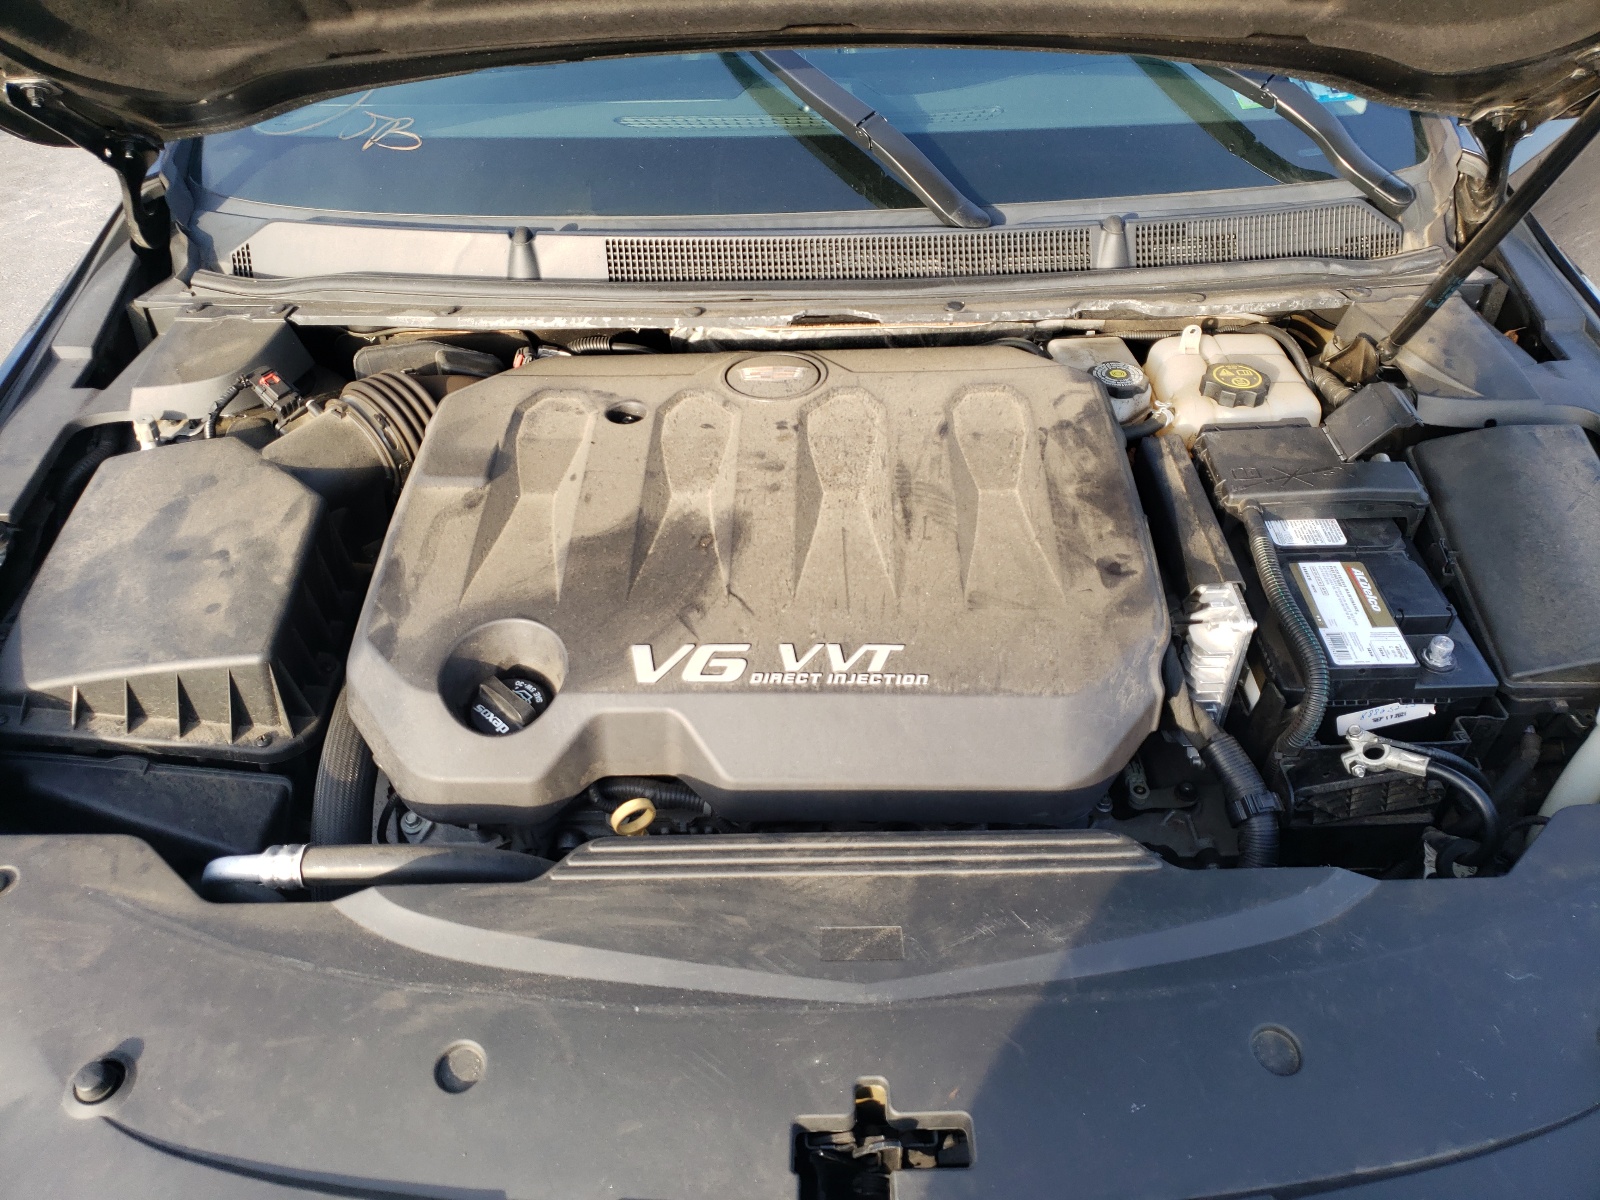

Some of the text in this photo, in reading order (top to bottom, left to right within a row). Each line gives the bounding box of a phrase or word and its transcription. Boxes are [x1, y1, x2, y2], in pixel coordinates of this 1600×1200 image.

[1350, 567, 1381, 612] ACDelco
[631, 643, 905, 683] V6 VVT
[749, 672, 929, 685] DIRECT INJECTION
[473, 704, 510, 734] dexos
